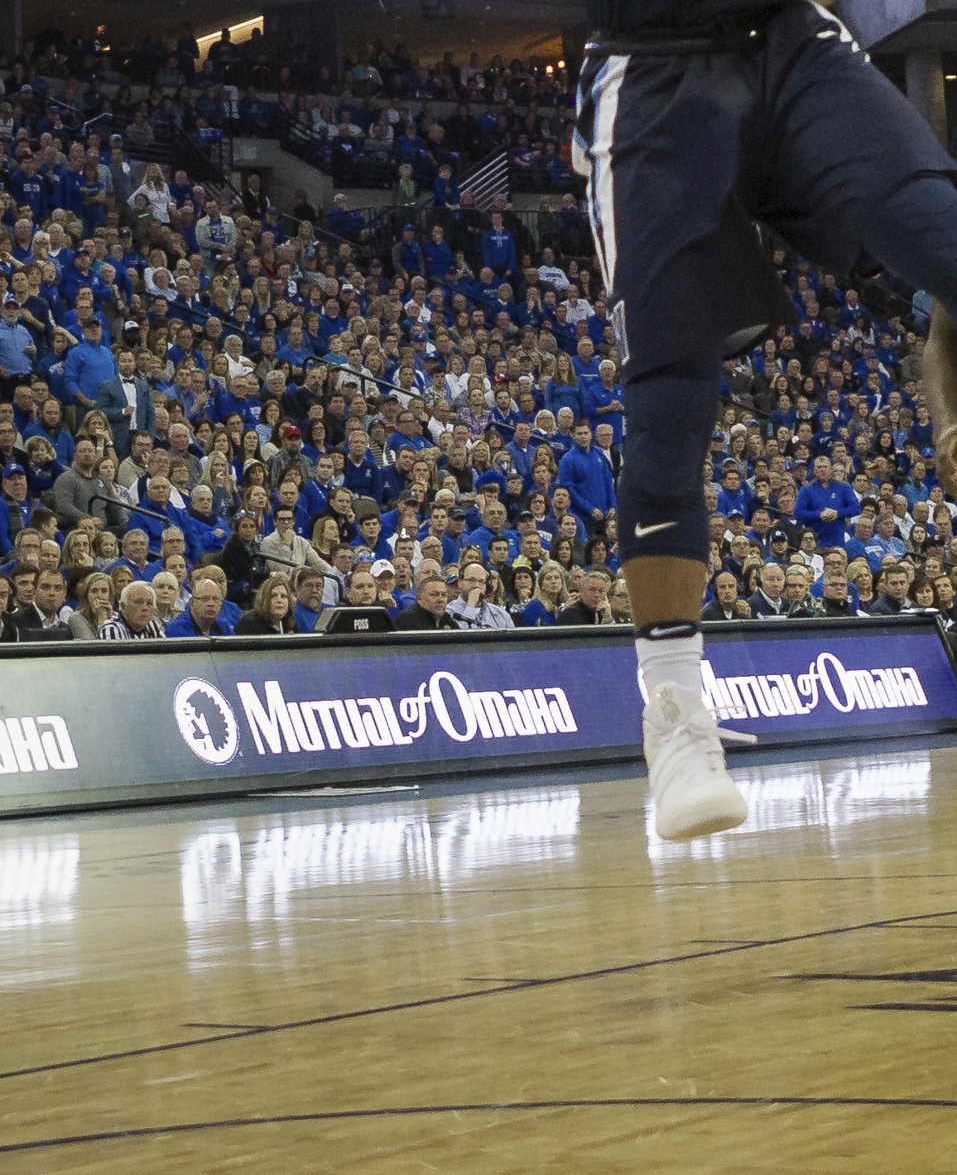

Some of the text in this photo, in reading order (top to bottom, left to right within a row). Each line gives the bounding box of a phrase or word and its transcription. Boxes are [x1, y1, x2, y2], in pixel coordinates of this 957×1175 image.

[354, 618, 369, 630] POSS
[797, 662, 821, 709] of
[400, 682, 433, 738] of
